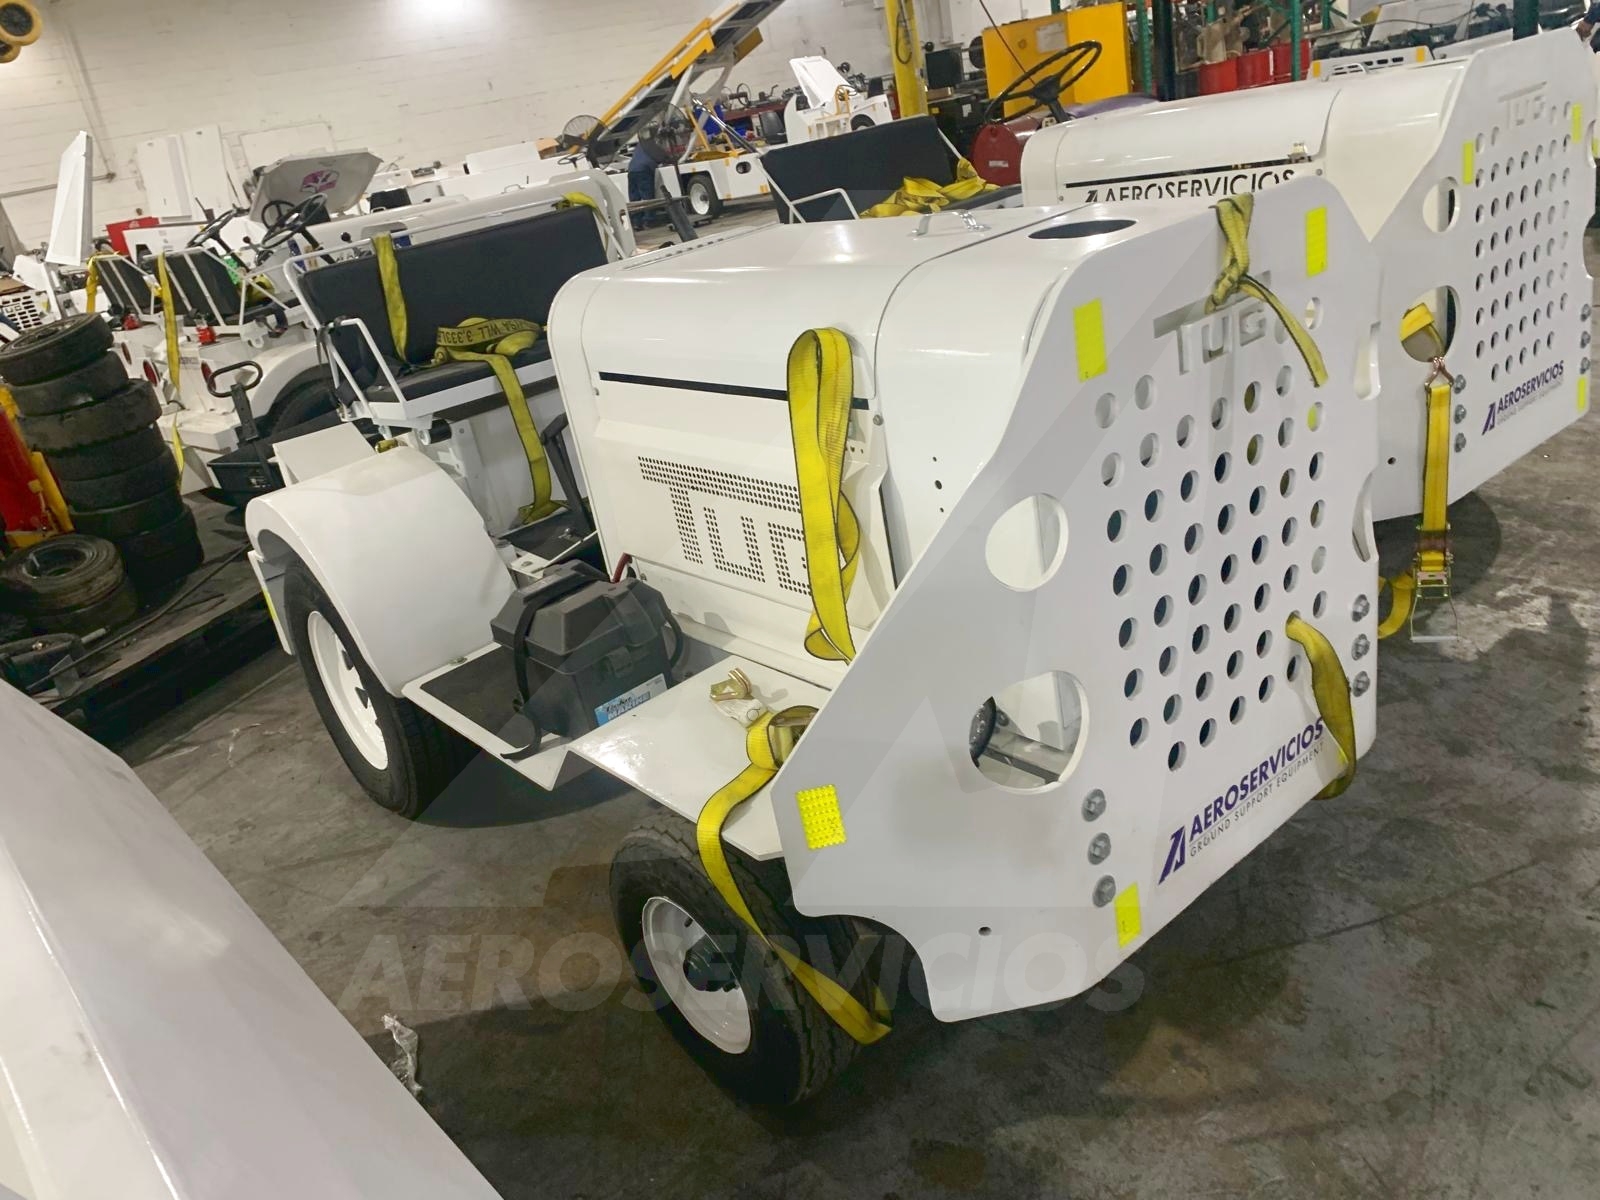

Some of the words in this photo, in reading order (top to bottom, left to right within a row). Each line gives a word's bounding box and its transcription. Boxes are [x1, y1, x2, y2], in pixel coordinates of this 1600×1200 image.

[1105, 169, 1295, 202] AEROSERVICIOS
[1153, 270, 1270, 376] TUG
[1497, 360, 1564, 414] AEROSERVICIOS
[1189, 717, 1324, 843] AEROSERVICIOS
[1190, 818, 1231, 857] GROUND
[1234, 784, 1273, 822] SUPPORT
[1276, 741, 1325, 788] EQUIPMENT
